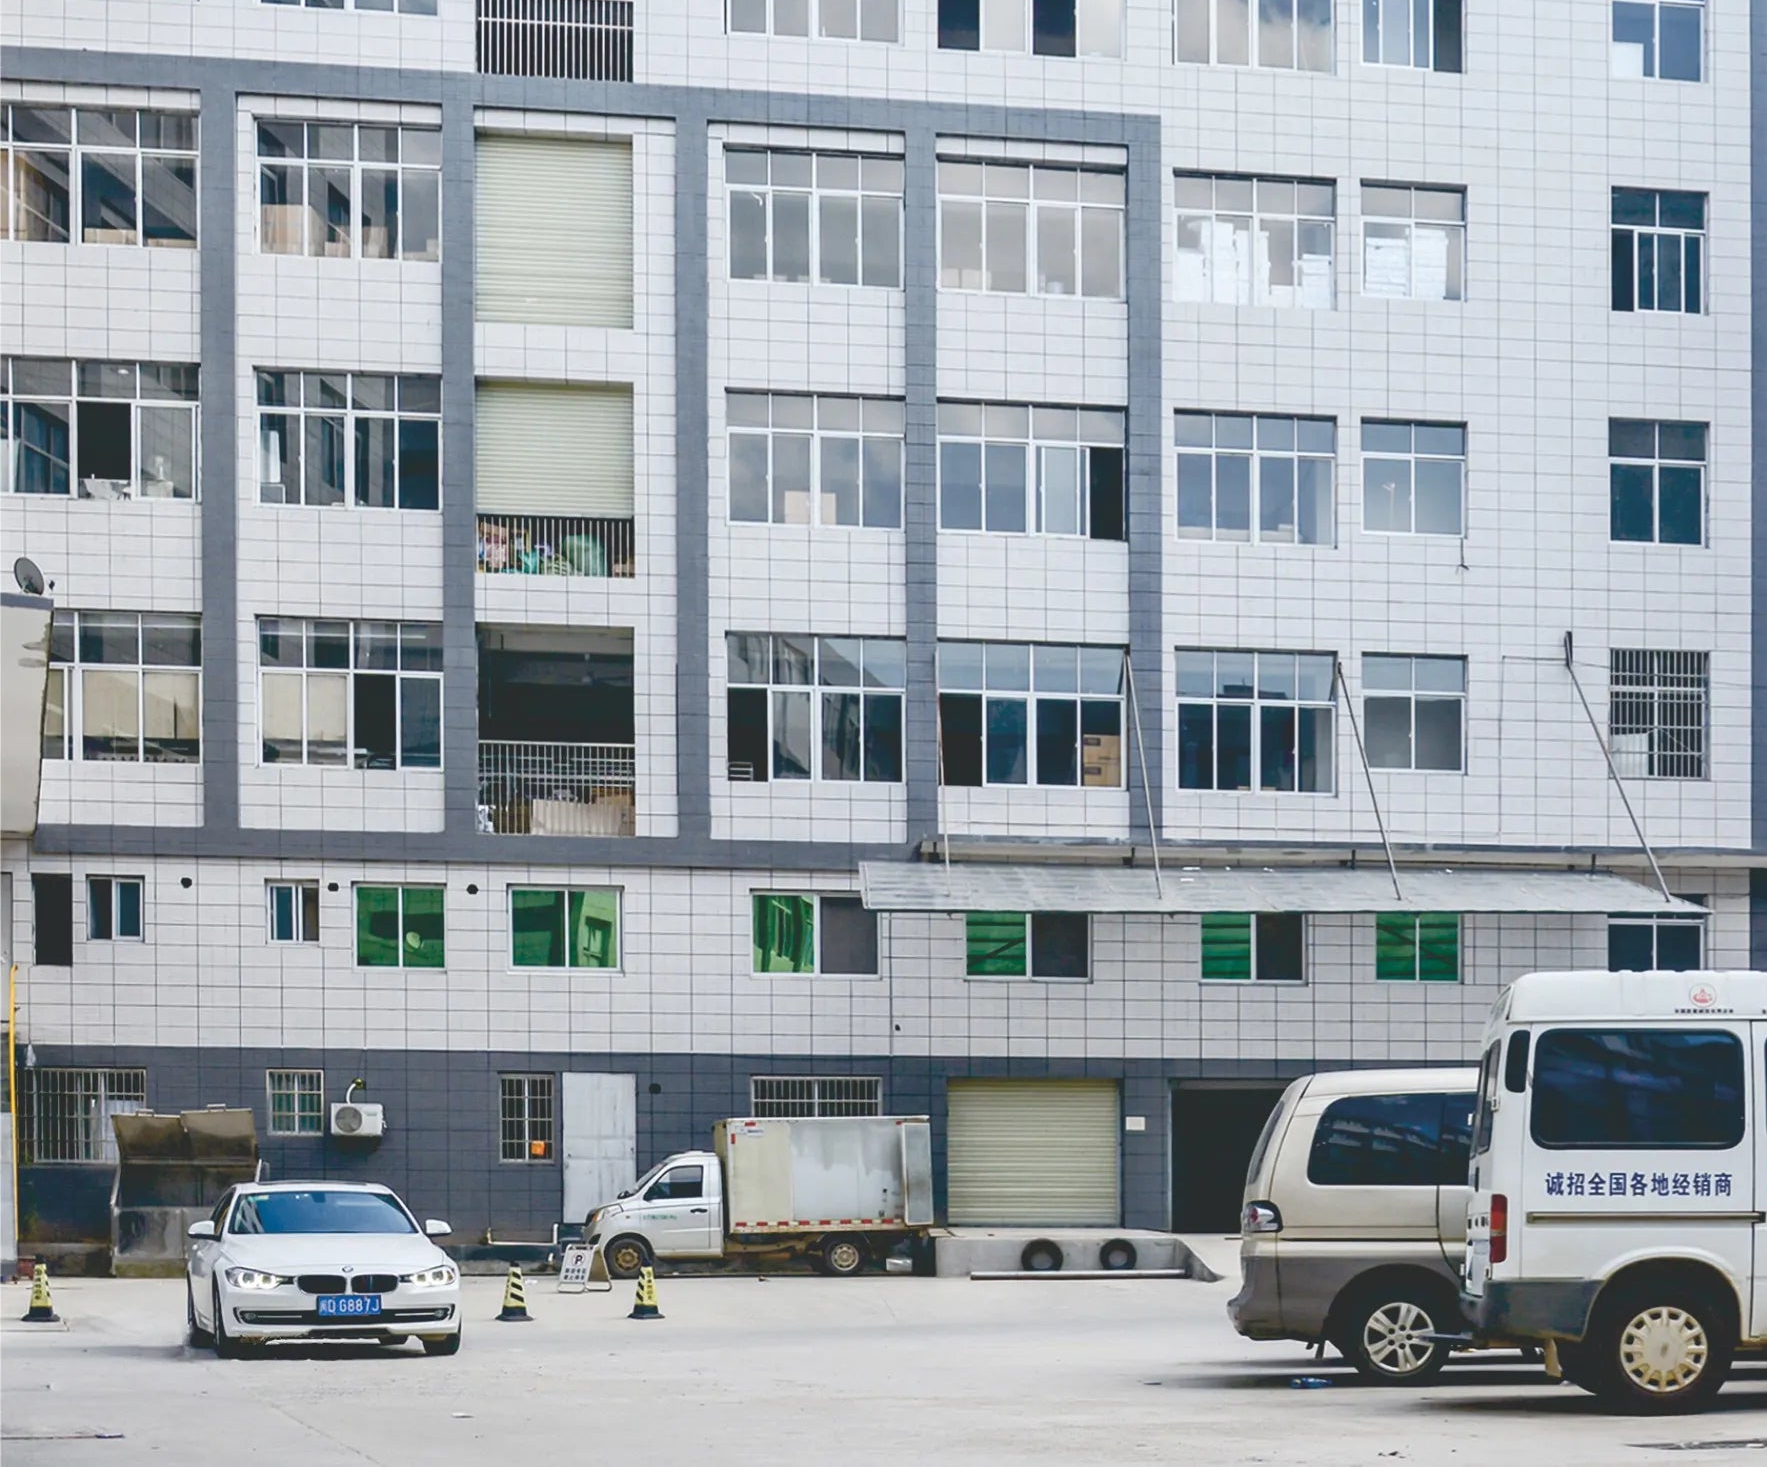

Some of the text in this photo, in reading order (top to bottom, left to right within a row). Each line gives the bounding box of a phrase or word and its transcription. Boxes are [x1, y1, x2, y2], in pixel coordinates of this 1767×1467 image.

[1545, 1172, 1732, 1196] 诚招全国各地经销商
